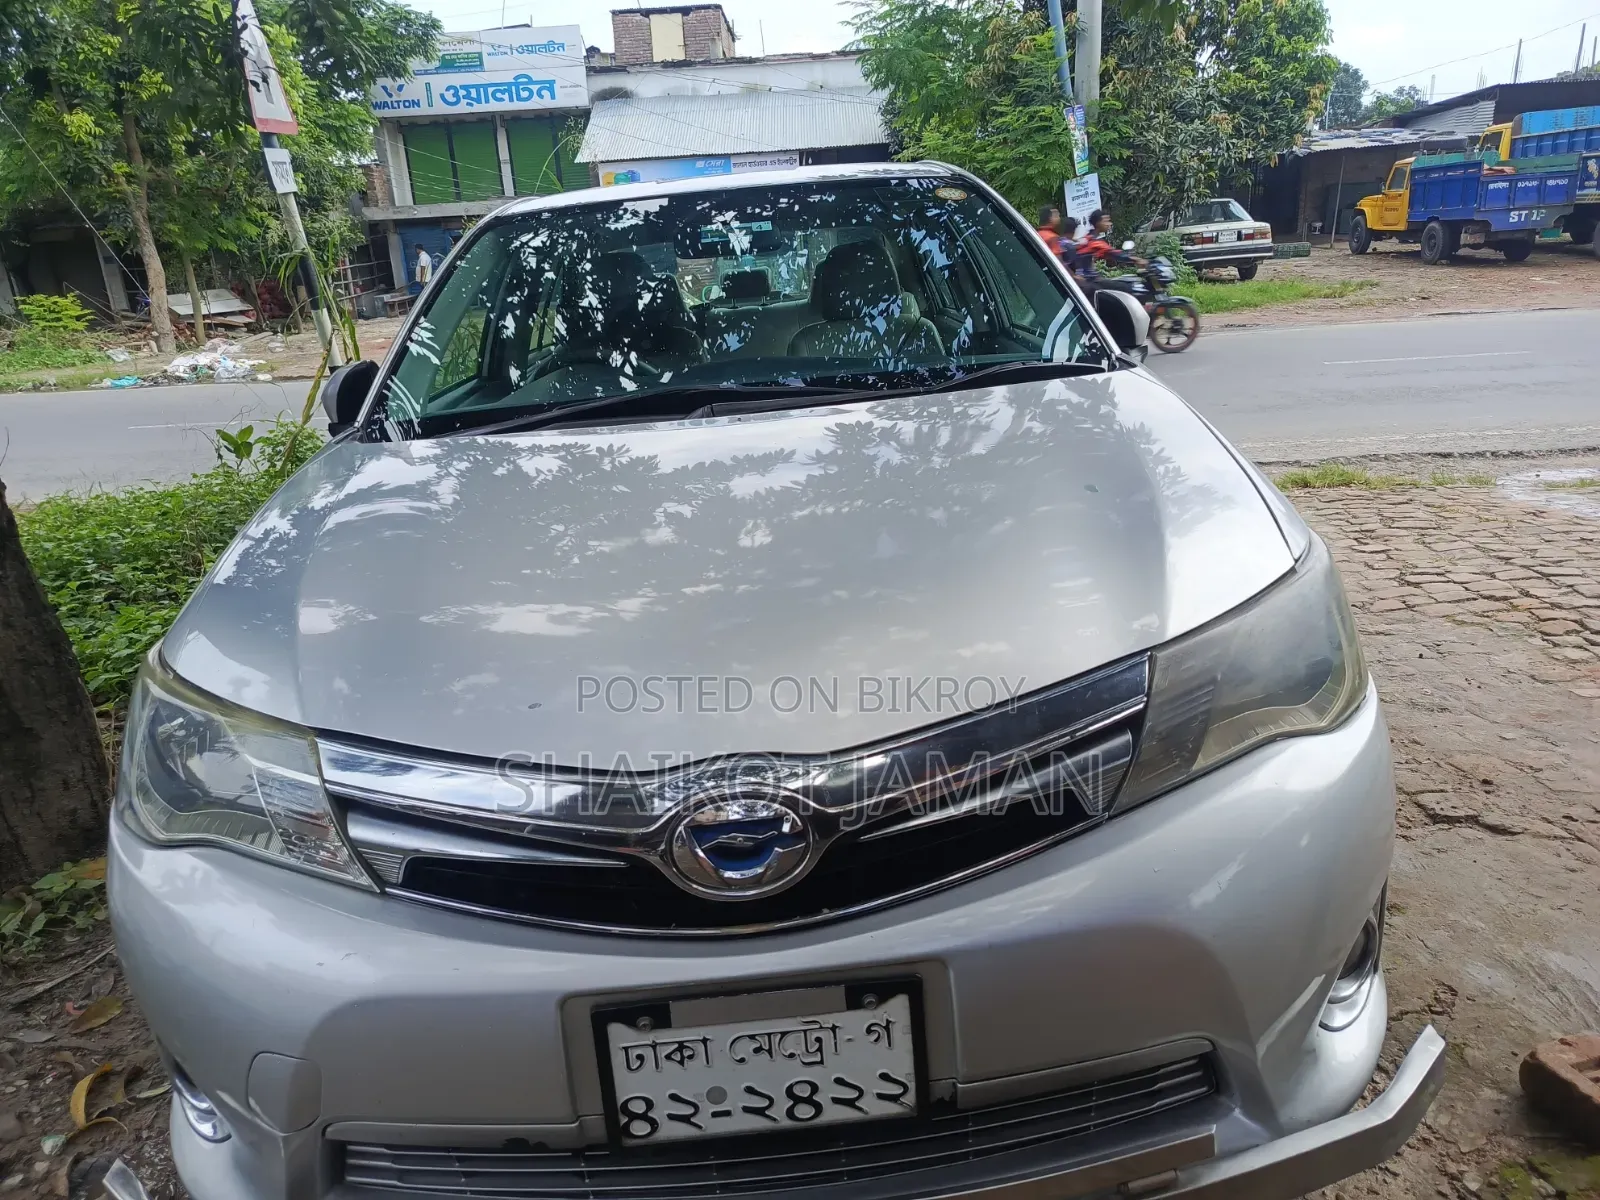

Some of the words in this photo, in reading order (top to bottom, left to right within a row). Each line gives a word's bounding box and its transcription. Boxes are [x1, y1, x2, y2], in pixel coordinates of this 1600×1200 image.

[371, 98, 421, 110] WALTON
[439, 74, 556, 108] ওয়ালটন
[620, 1036, 712, 1072] ঢাকা
